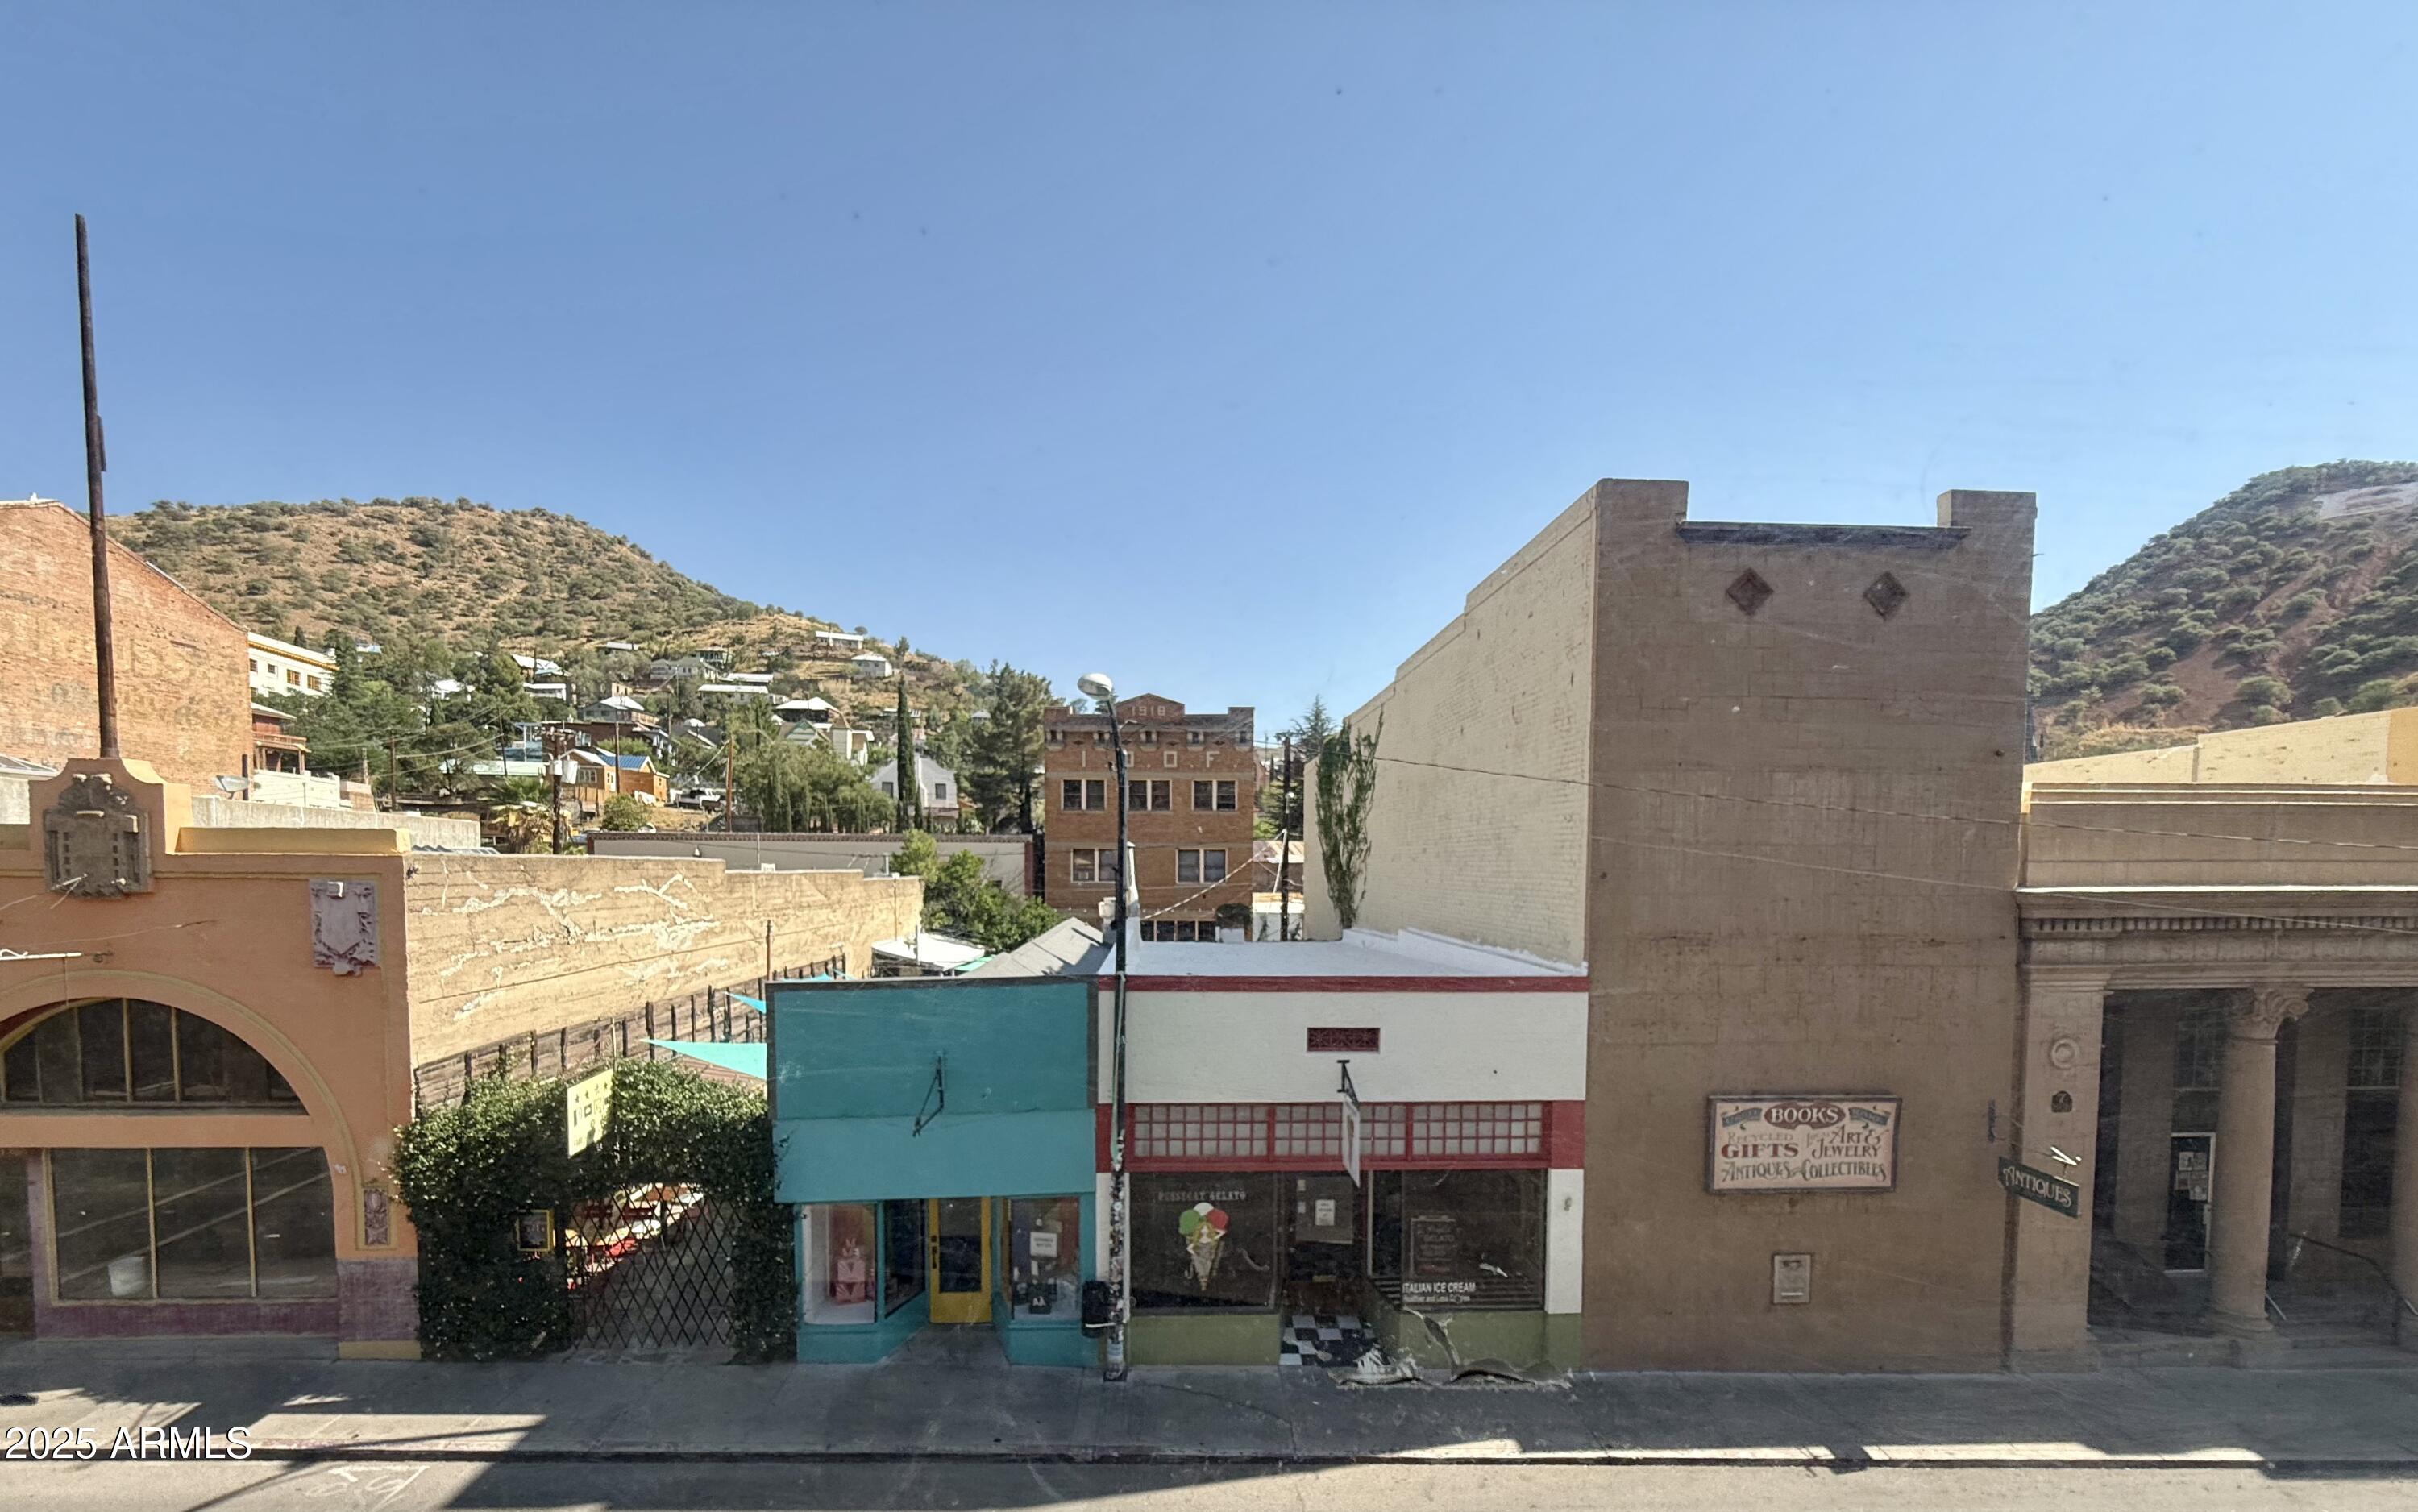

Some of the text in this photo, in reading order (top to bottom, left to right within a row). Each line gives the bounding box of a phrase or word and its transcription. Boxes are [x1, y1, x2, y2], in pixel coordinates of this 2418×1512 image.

[1132, 706, 1165, 717] 1918
[1771, 1107, 1838, 1124] BOOKS
[1727, 1132, 1793, 1144] RECYCLED
[1865, 1128, 1888, 1145] &
[1721, 1143, 1799, 1158] GIFTS
[1811, 1138, 1881, 1159] JEWELRY
[1721, 1160, 1792, 1182] ANTIQUES
[1801, 1159, 1887, 1182] COLLECTIBLES
[2002, 1165, 2071, 1207] ANTIQUES
[1209, 1190, 1247, 1201] GELATO
[1402, 1282, 1476, 1294] ITALIAN ICE CREAM
